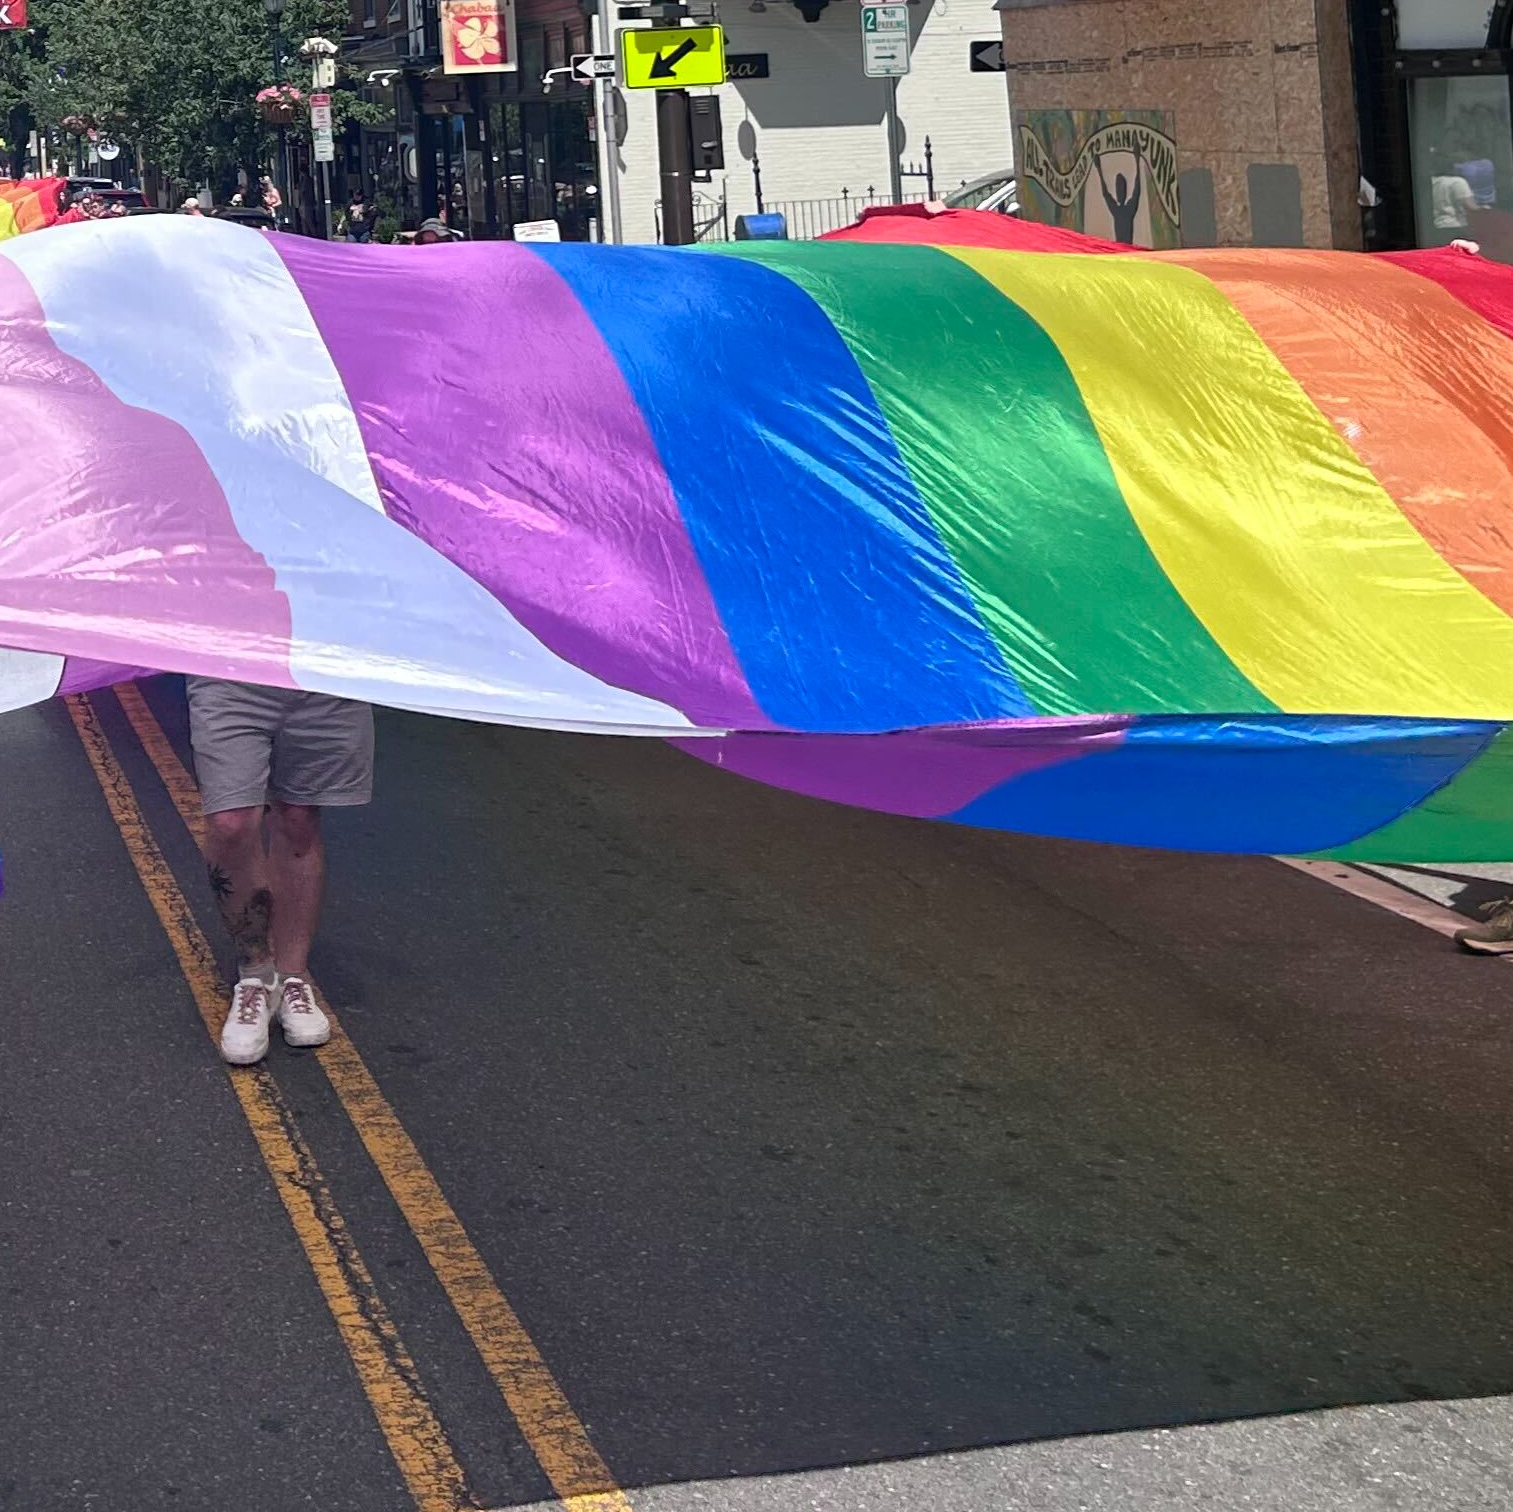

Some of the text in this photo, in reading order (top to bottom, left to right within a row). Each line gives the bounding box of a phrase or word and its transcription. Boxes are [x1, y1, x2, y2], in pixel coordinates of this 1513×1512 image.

[866, 12, 875, 29] 2
[594, 60, 613, 71] ONE
[1106, 129, 1178, 216] MANAYUNK
